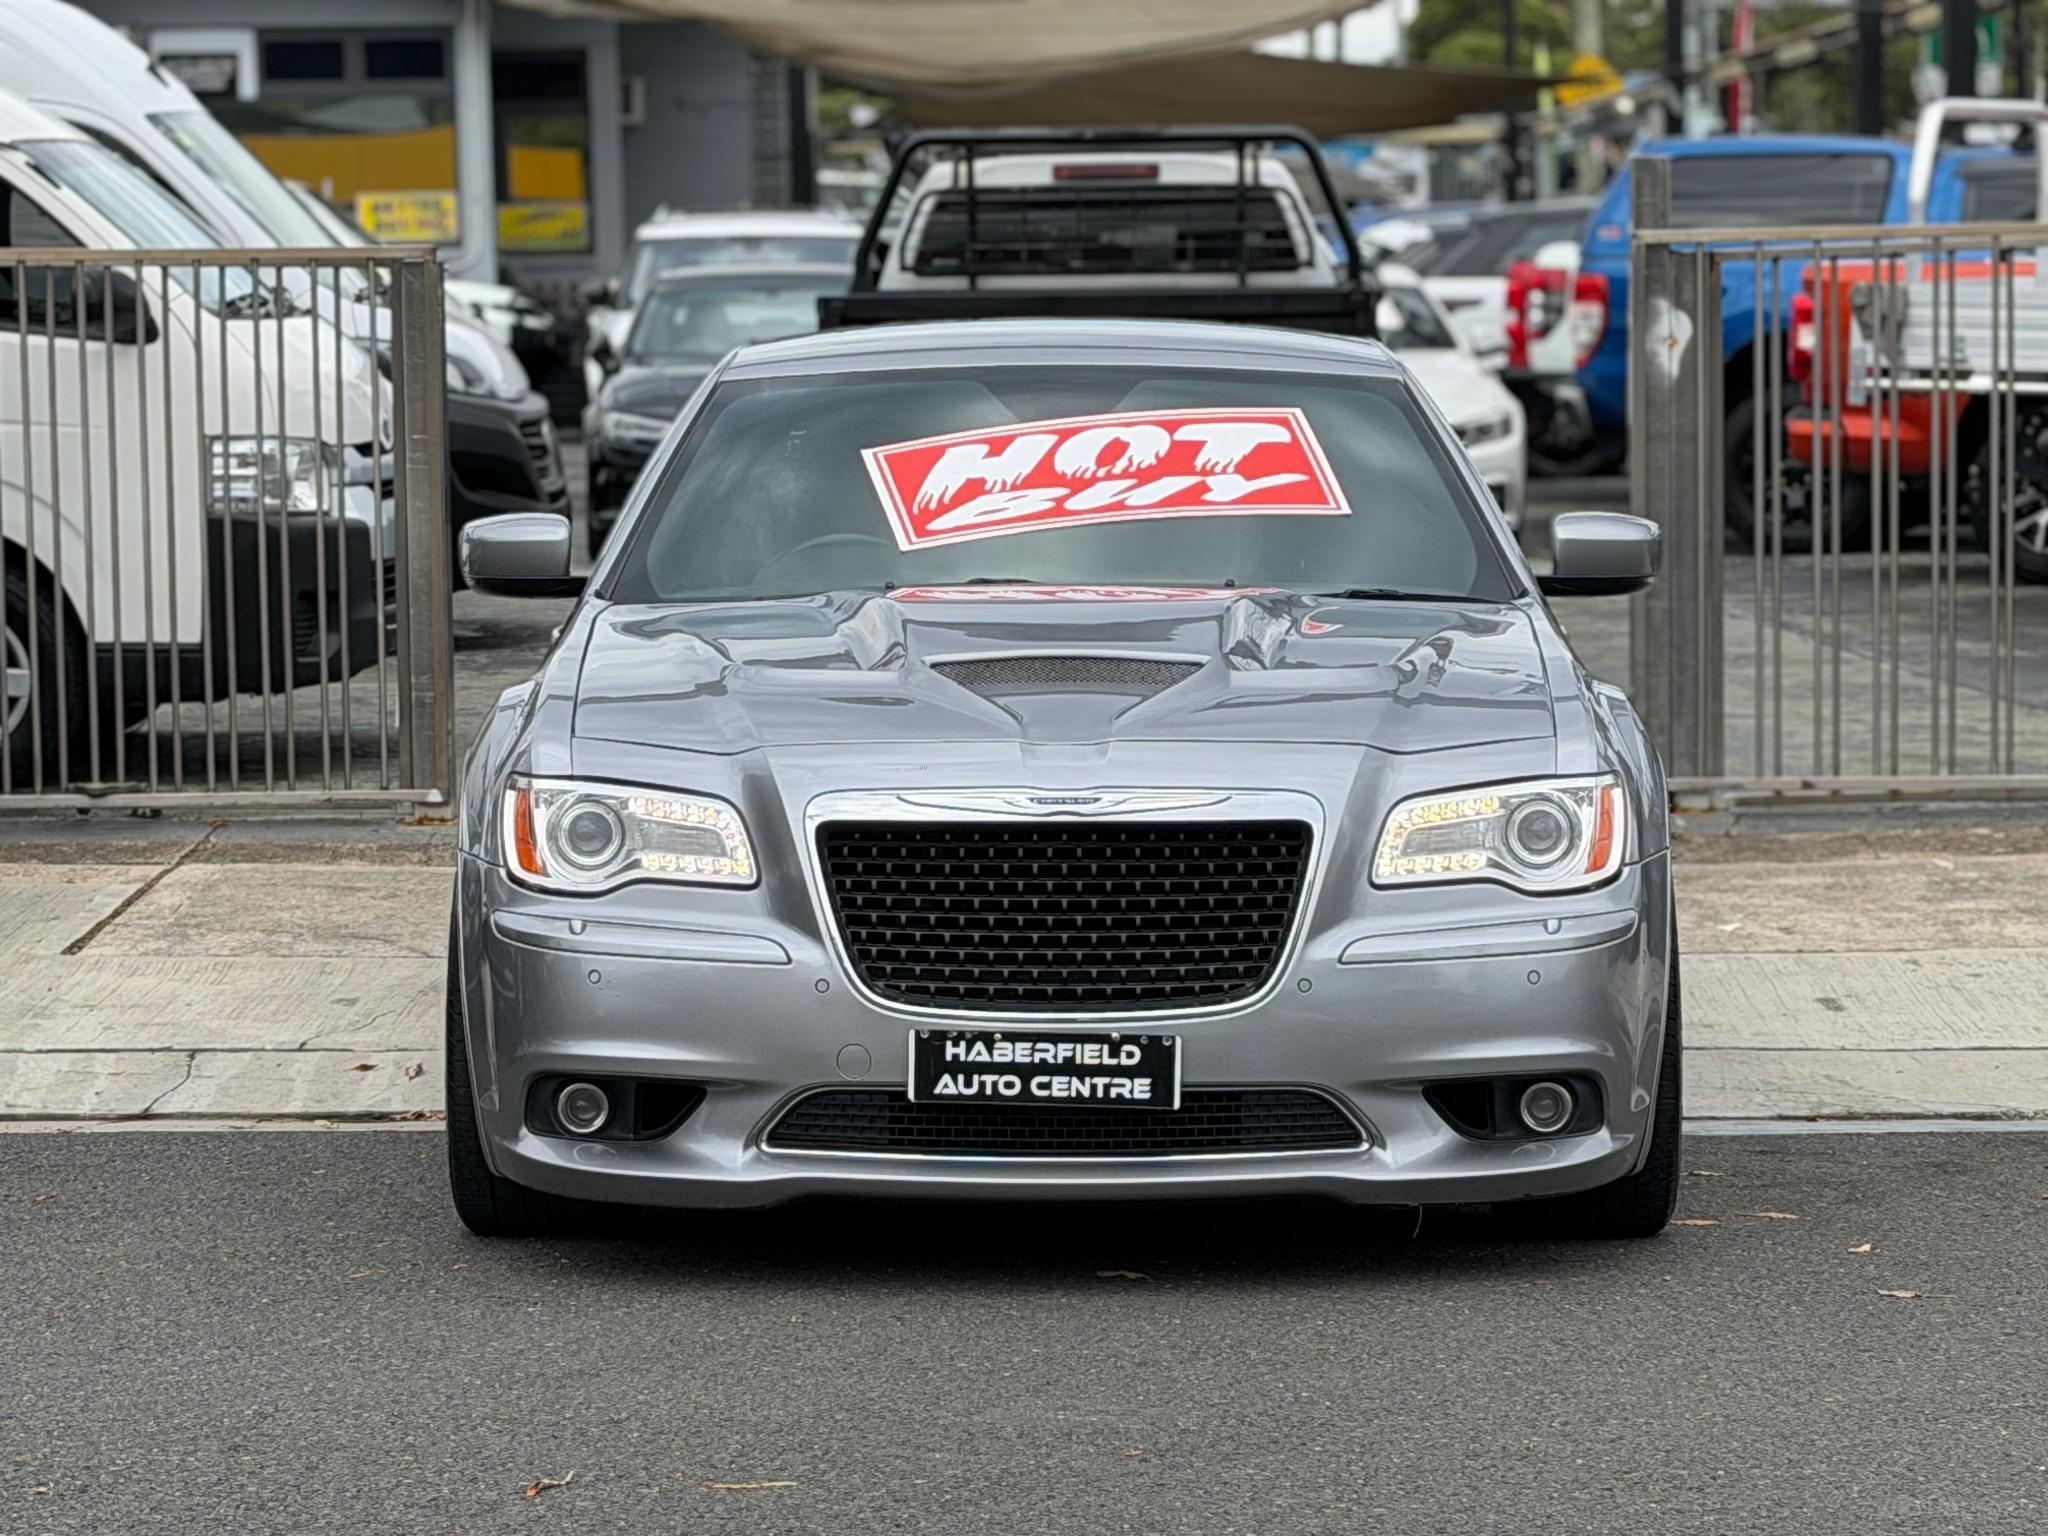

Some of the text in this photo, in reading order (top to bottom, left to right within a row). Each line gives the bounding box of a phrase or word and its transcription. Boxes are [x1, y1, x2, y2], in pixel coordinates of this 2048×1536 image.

[913, 422, 1292, 515] HOT
[925, 473, 1311, 531] BUY
[944, 1040, 1142, 1066] HABERFIELD
[933, 1073, 1153, 1099] AUTO CENTRE
